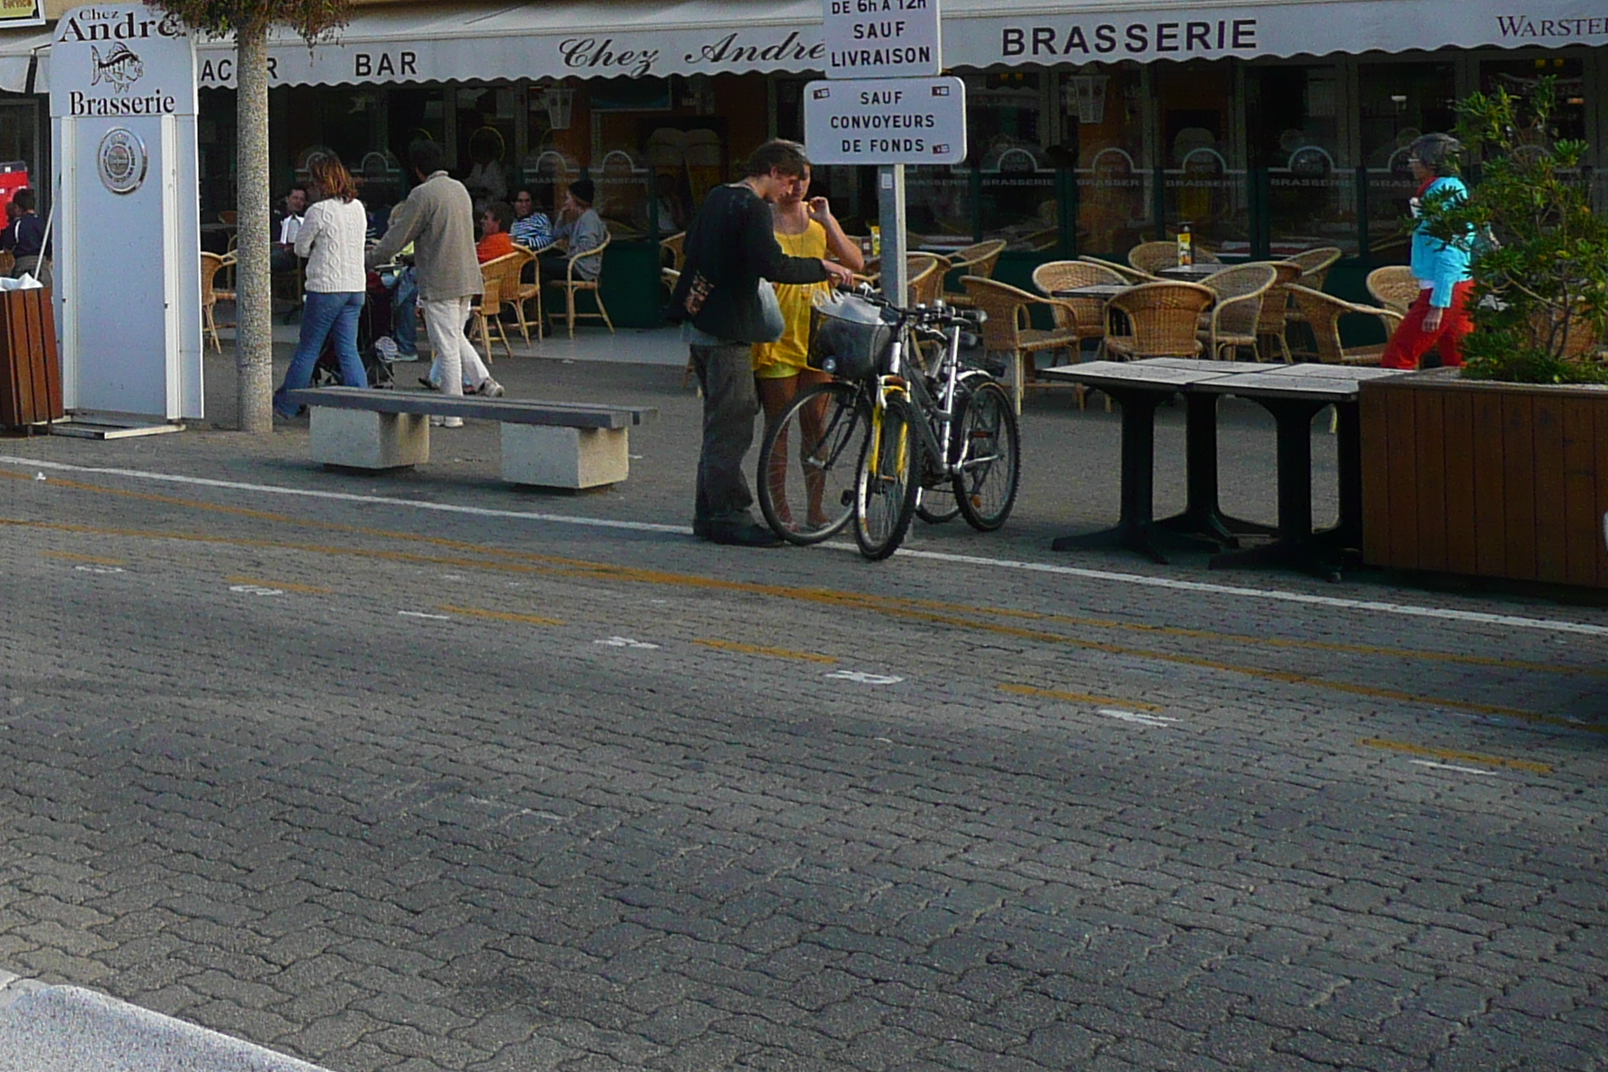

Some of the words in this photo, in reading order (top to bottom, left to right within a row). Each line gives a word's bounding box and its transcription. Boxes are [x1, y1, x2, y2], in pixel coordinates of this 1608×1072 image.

[79, 8, 120, 21] Chez
[831, 1, 851, 15] DE
[853, 21, 906, 39] SAUF
[355, 51, 418, 77] BAR
[558, 37, 660, 77] Chez
[1002, 18, 1257, 57] BRASSERIE
[831, 45, 931, 68] LIVRAISON
[69, 88, 176, 115] Brasserie
[860, 91, 903, 105] SAUF
[830, 114, 935, 129] CONVOYEURS
[841, 139, 862, 153] DE
[870, 138, 925, 153] FONDS
[982, 178, 1055, 186] BRASSERIE
[1076, 179, 1154, 187] BRASSERE
